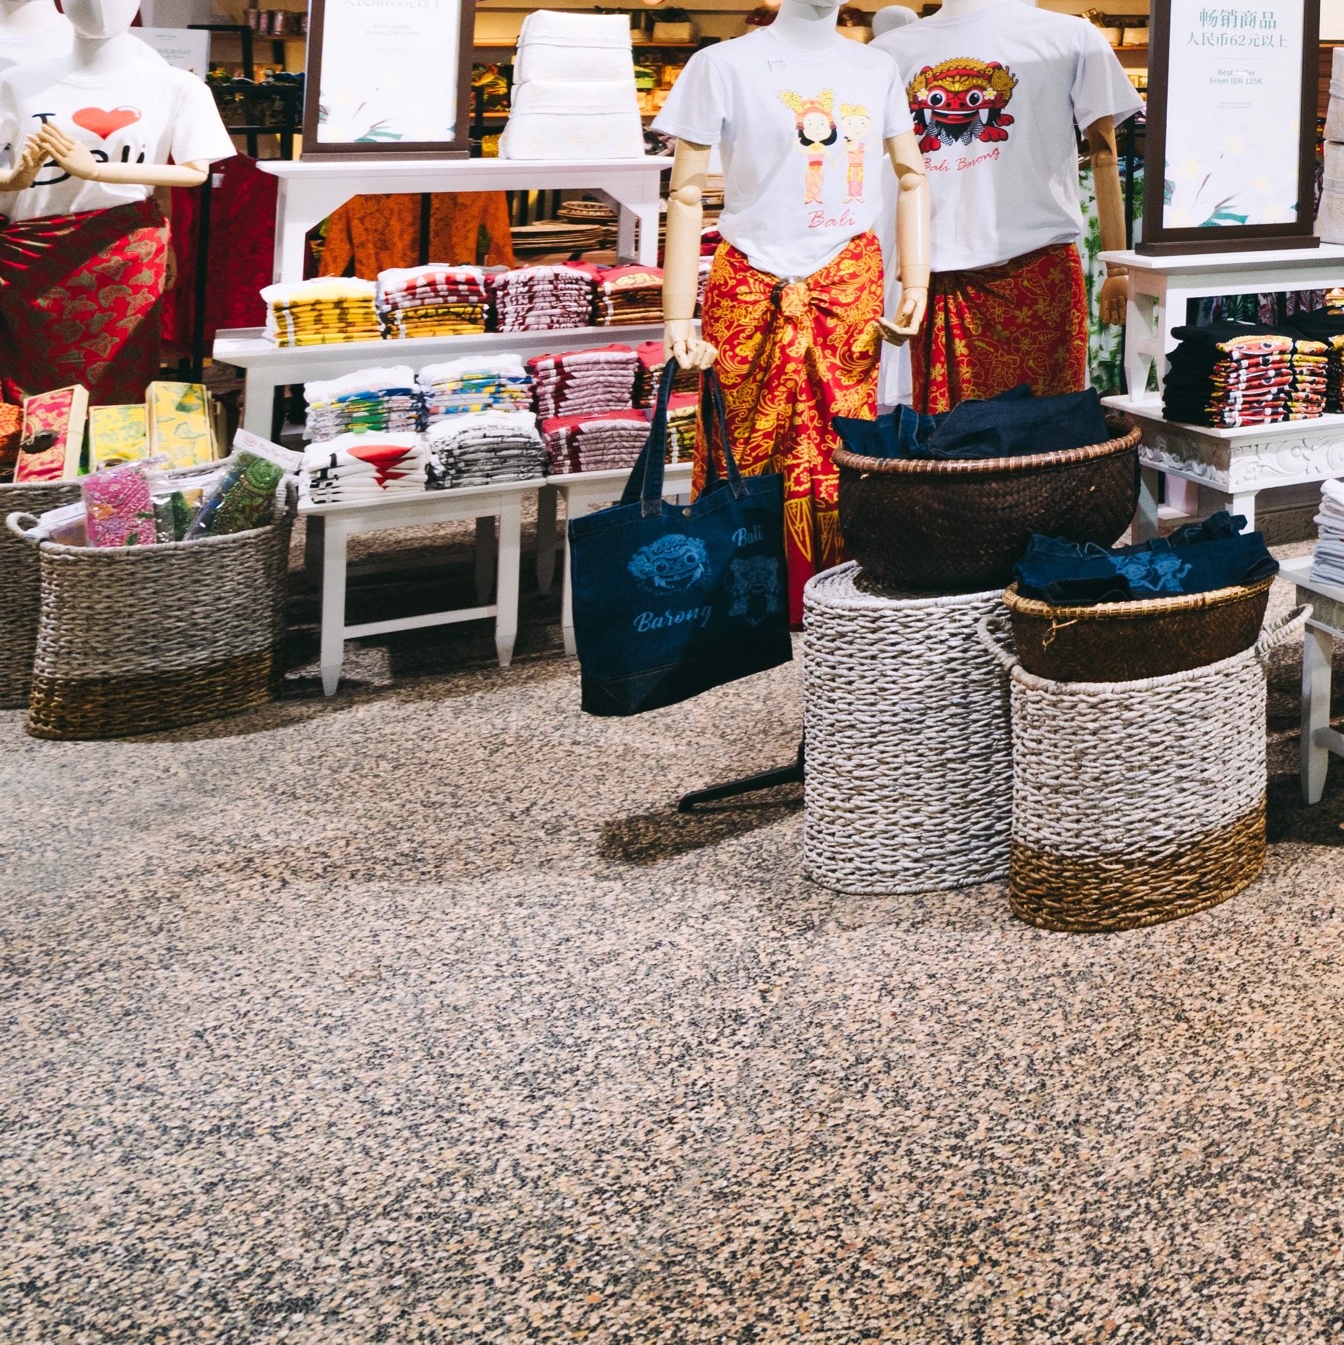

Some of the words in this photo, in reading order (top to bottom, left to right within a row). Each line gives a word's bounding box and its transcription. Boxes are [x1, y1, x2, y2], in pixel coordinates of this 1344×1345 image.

[1199, 8, 1277, 29] 畅销商品
[1186, 32, 1288, 48] 人民币62元以上
[808, 209, 856, 229] Bali
[732, 525, 763, 547] Bali
[633, 605, 712, 632] Barong
